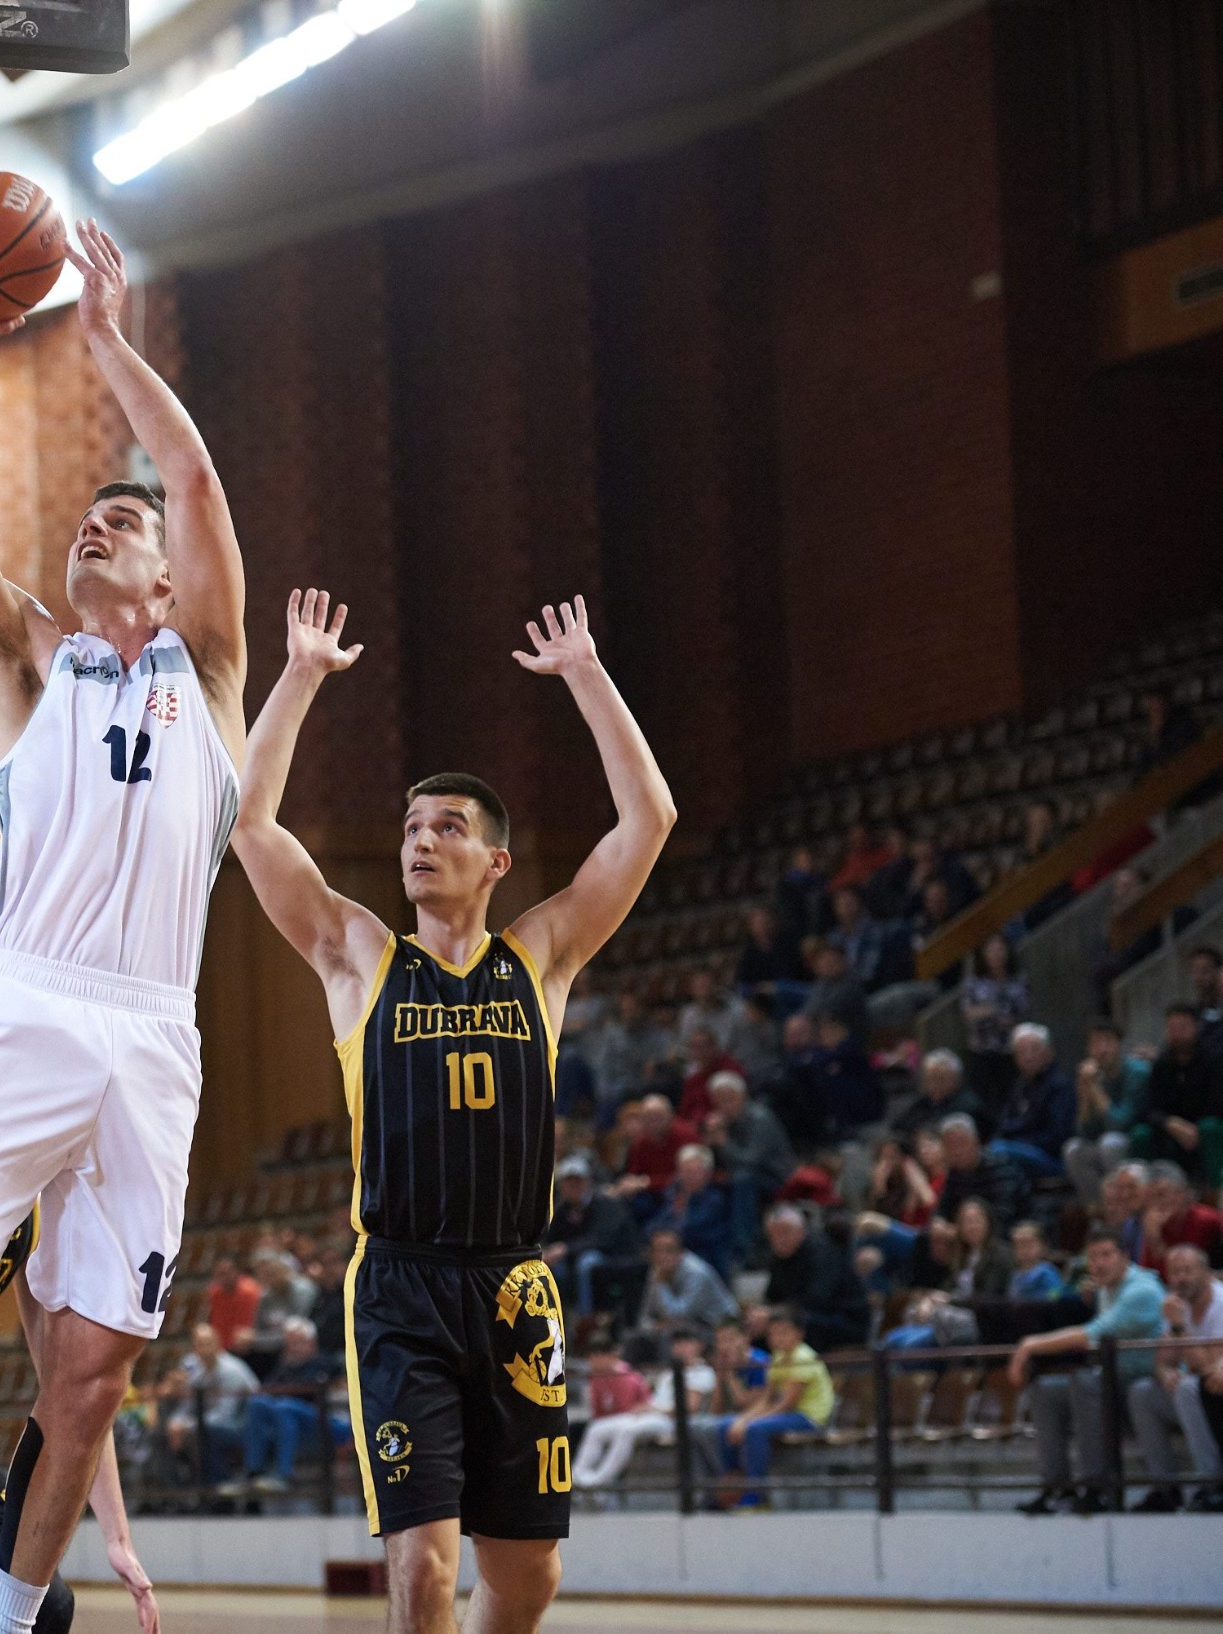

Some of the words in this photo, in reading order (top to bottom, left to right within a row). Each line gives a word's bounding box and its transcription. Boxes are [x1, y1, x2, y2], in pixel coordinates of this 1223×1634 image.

[394, 1000, 531, 1043] DUBRAVA
[446, 1052, 496, 1110] 10
[536, 1436, 572, 1494] 10
